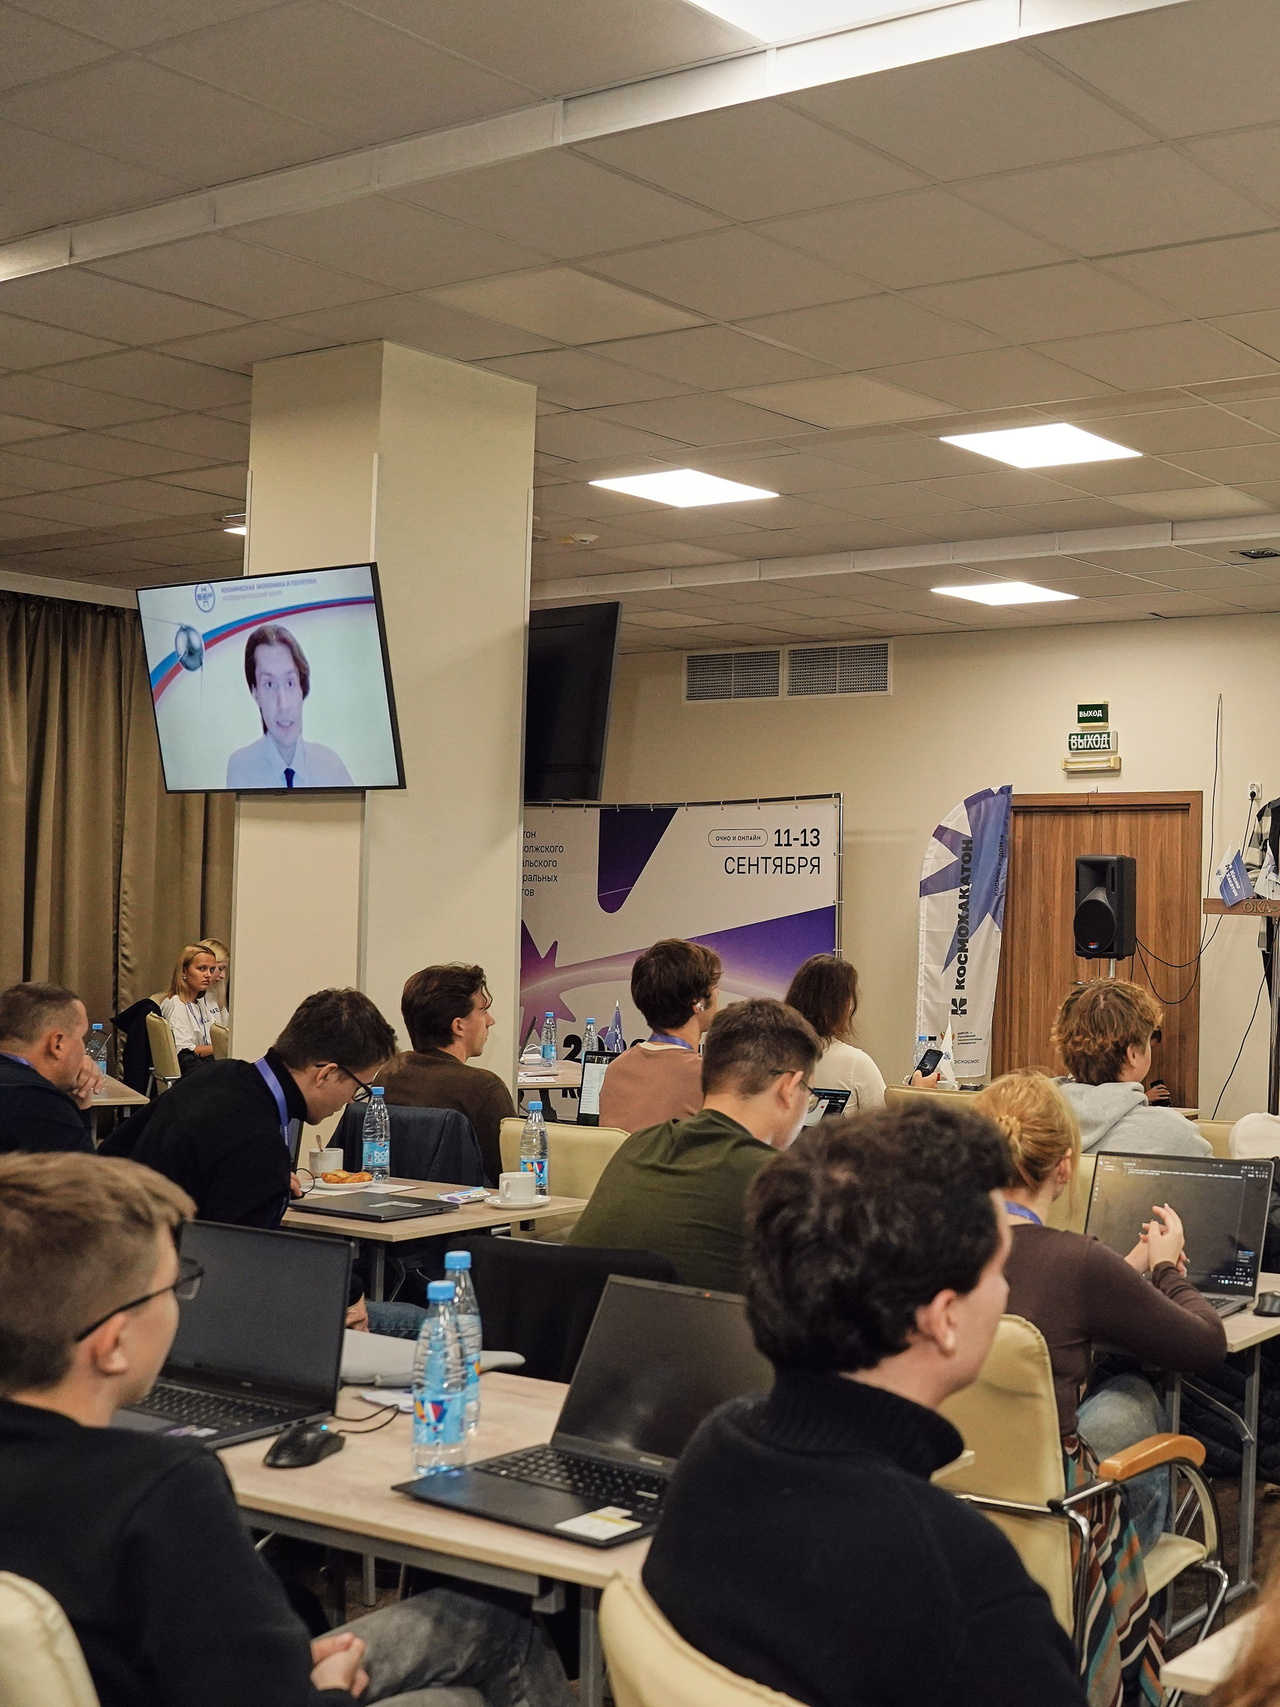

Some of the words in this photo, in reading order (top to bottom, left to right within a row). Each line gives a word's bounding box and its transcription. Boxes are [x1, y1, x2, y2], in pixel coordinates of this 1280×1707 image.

[1070, 734, 1109, 749] ВЫХОД
[738, 833, 761, 842] ОНЛАЙН
[774, 828, 821, 847] 11-13
[523, 845, 564, 853] олжского
[724, 856, 821, 875] СЕНТЯБРЯ
[955, 839, 973, 990] КОСМОХАКАТОН
